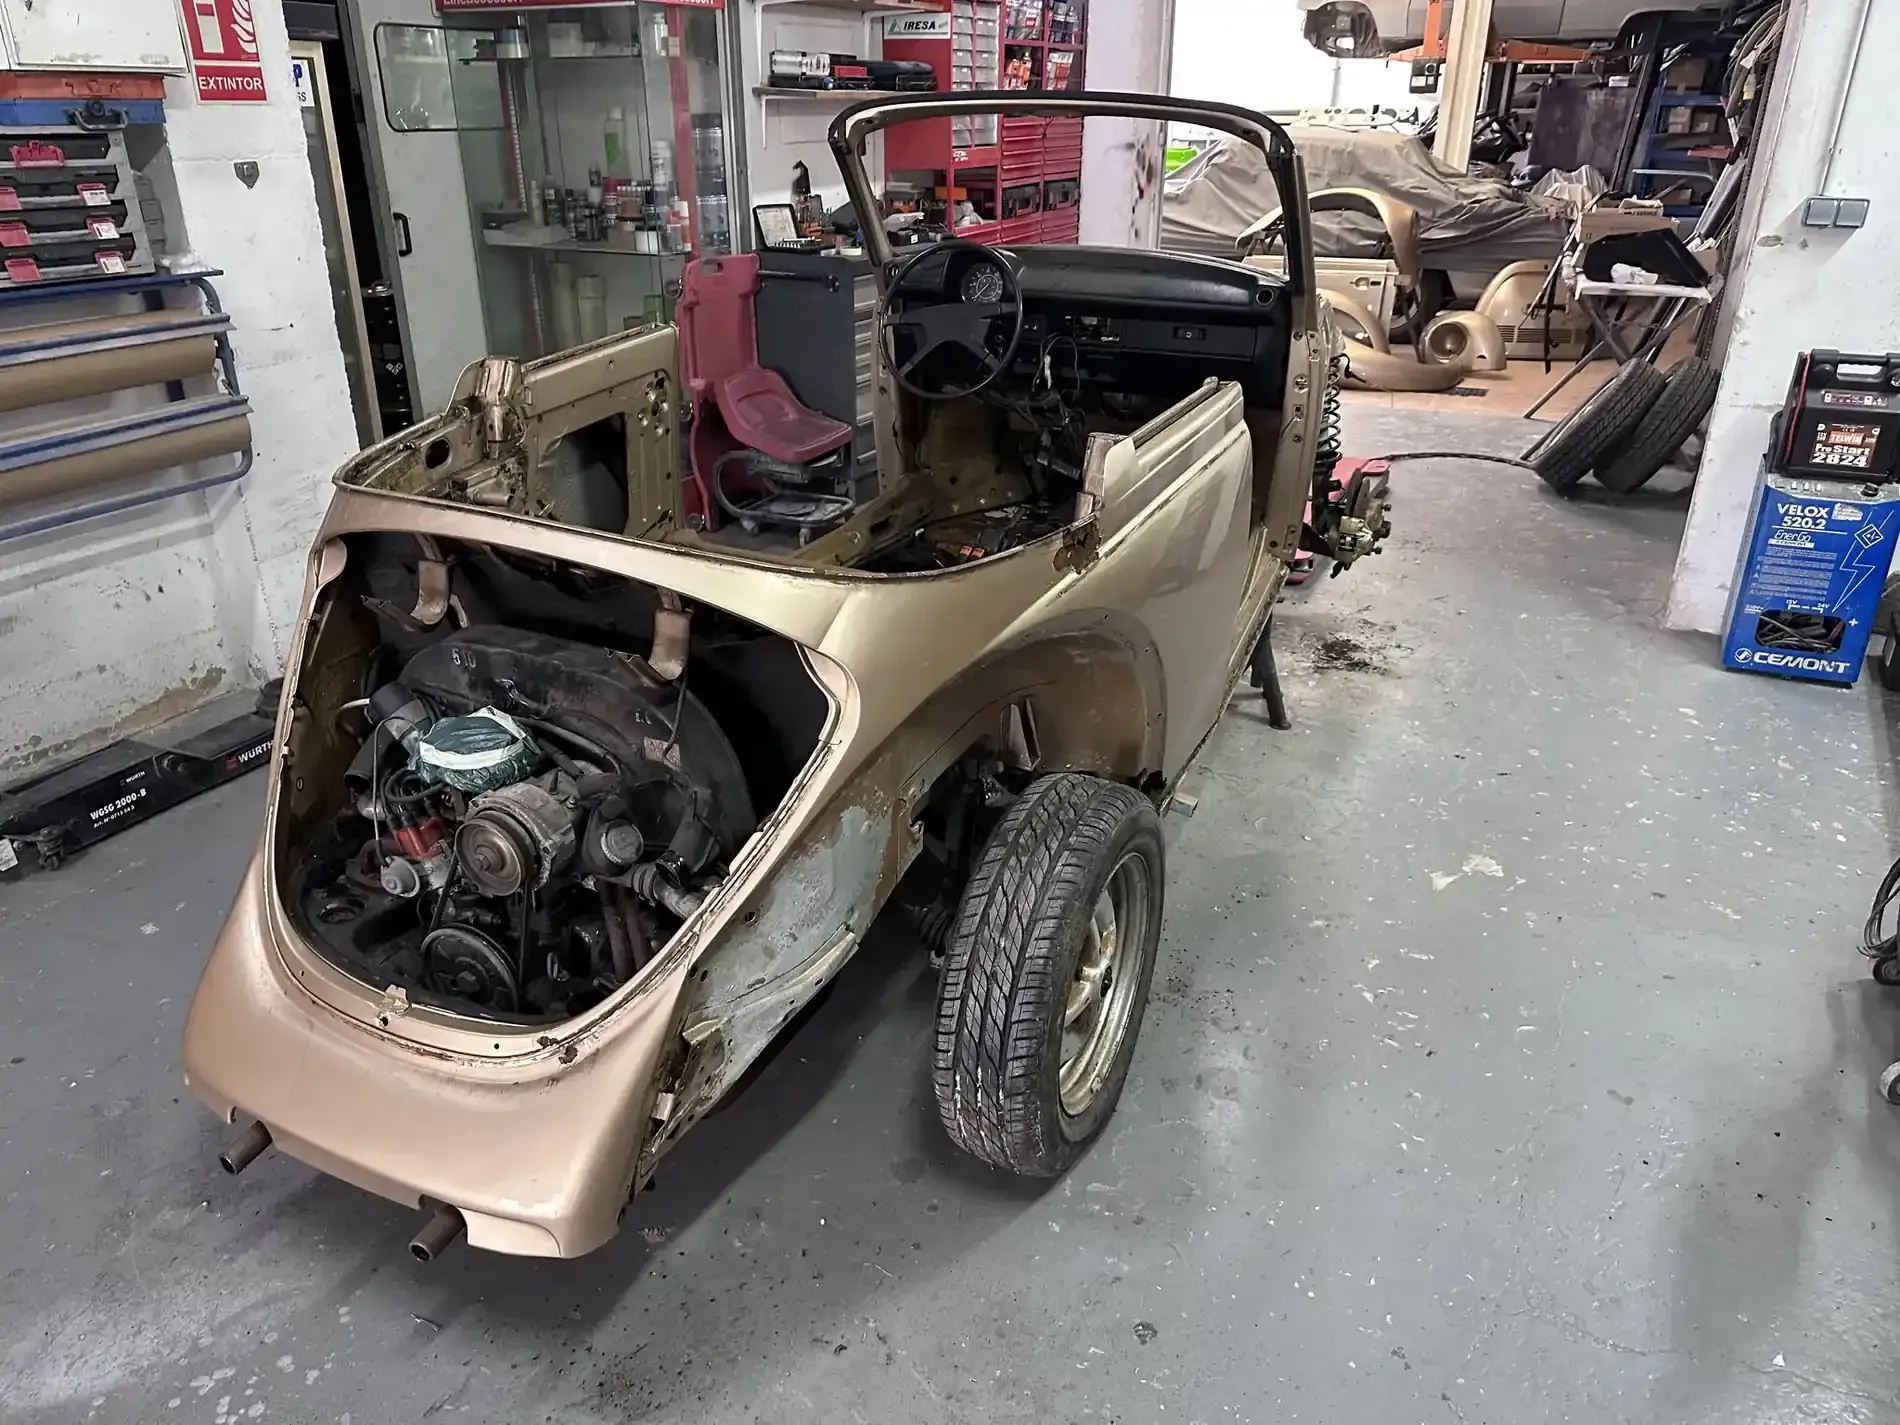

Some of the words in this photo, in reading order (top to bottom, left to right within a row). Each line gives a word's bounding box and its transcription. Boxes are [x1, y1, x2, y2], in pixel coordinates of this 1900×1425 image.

[903, 20, 936, 31] IRESA
[198, 76, 263, 90] EXTINTOR
[1815, 443, 1832, 453] Pro
[1832, 444, 1870, 456] Start
[1811, 452, 1867, 467] 2824
[1777, 503, 1830, 518] VELOX
[1782, 516, 1827, 530] 520.2
[1753, 651, 1851, 674] CEMONT
[89, 803, 115, 820] WGSG
[115, 788, 147, 809] 2000-B
